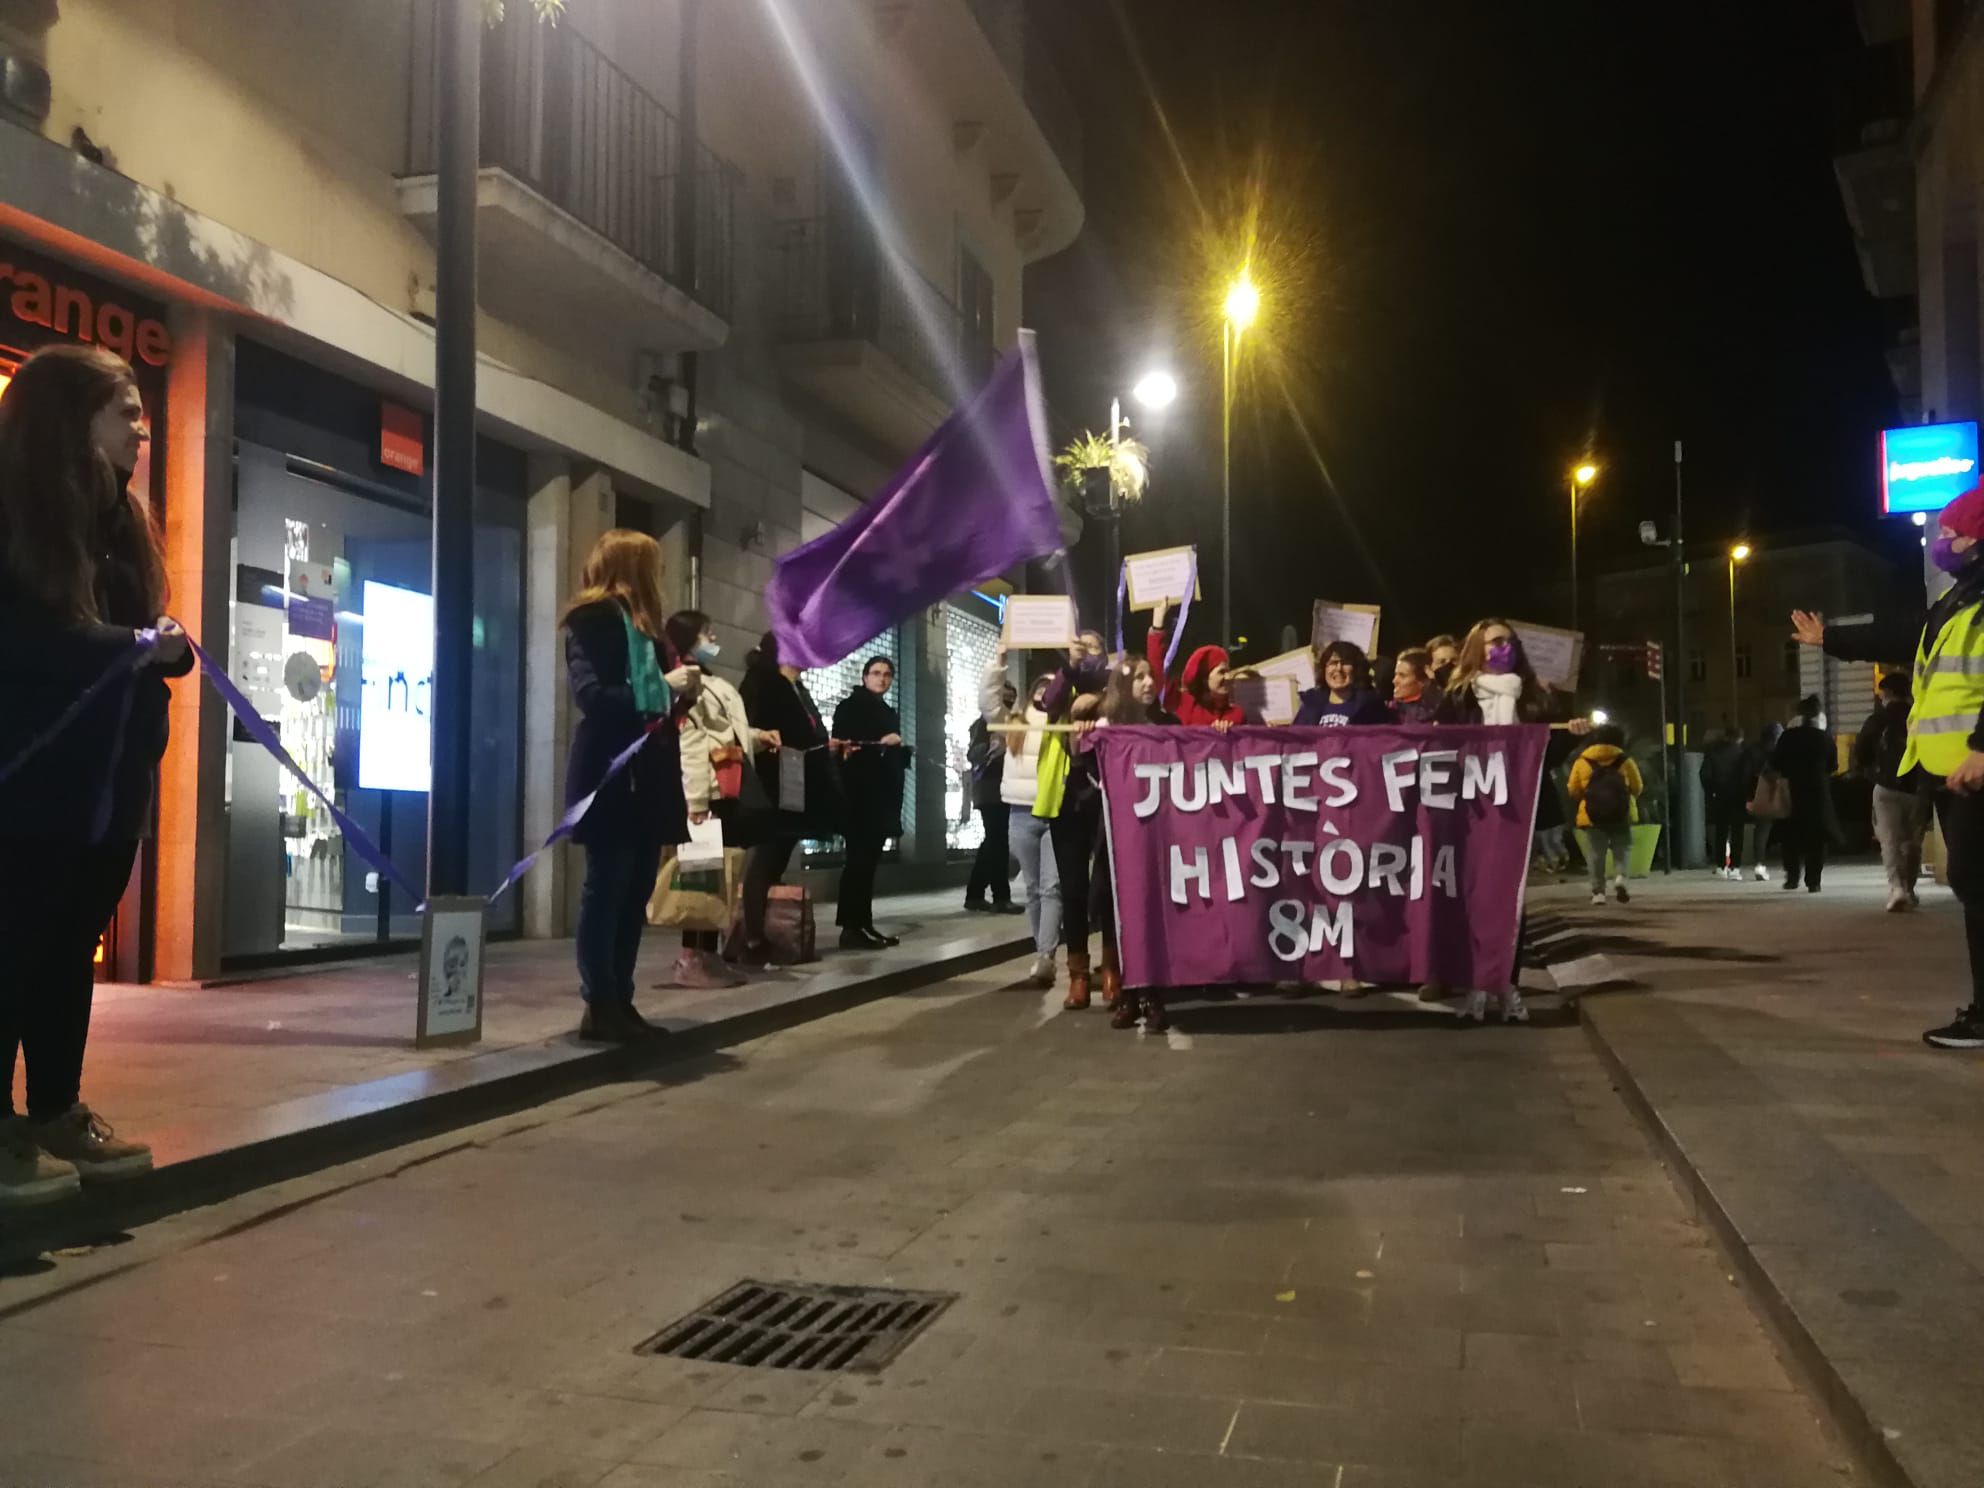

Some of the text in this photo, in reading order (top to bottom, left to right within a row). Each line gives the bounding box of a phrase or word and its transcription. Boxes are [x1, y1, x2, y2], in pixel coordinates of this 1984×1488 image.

[1133, 749, 1508, 817] JUNTES FEM
[1170, 820, 1457, 904] HISTÒRIA
[1268, 899, 1354, 960] 8M
